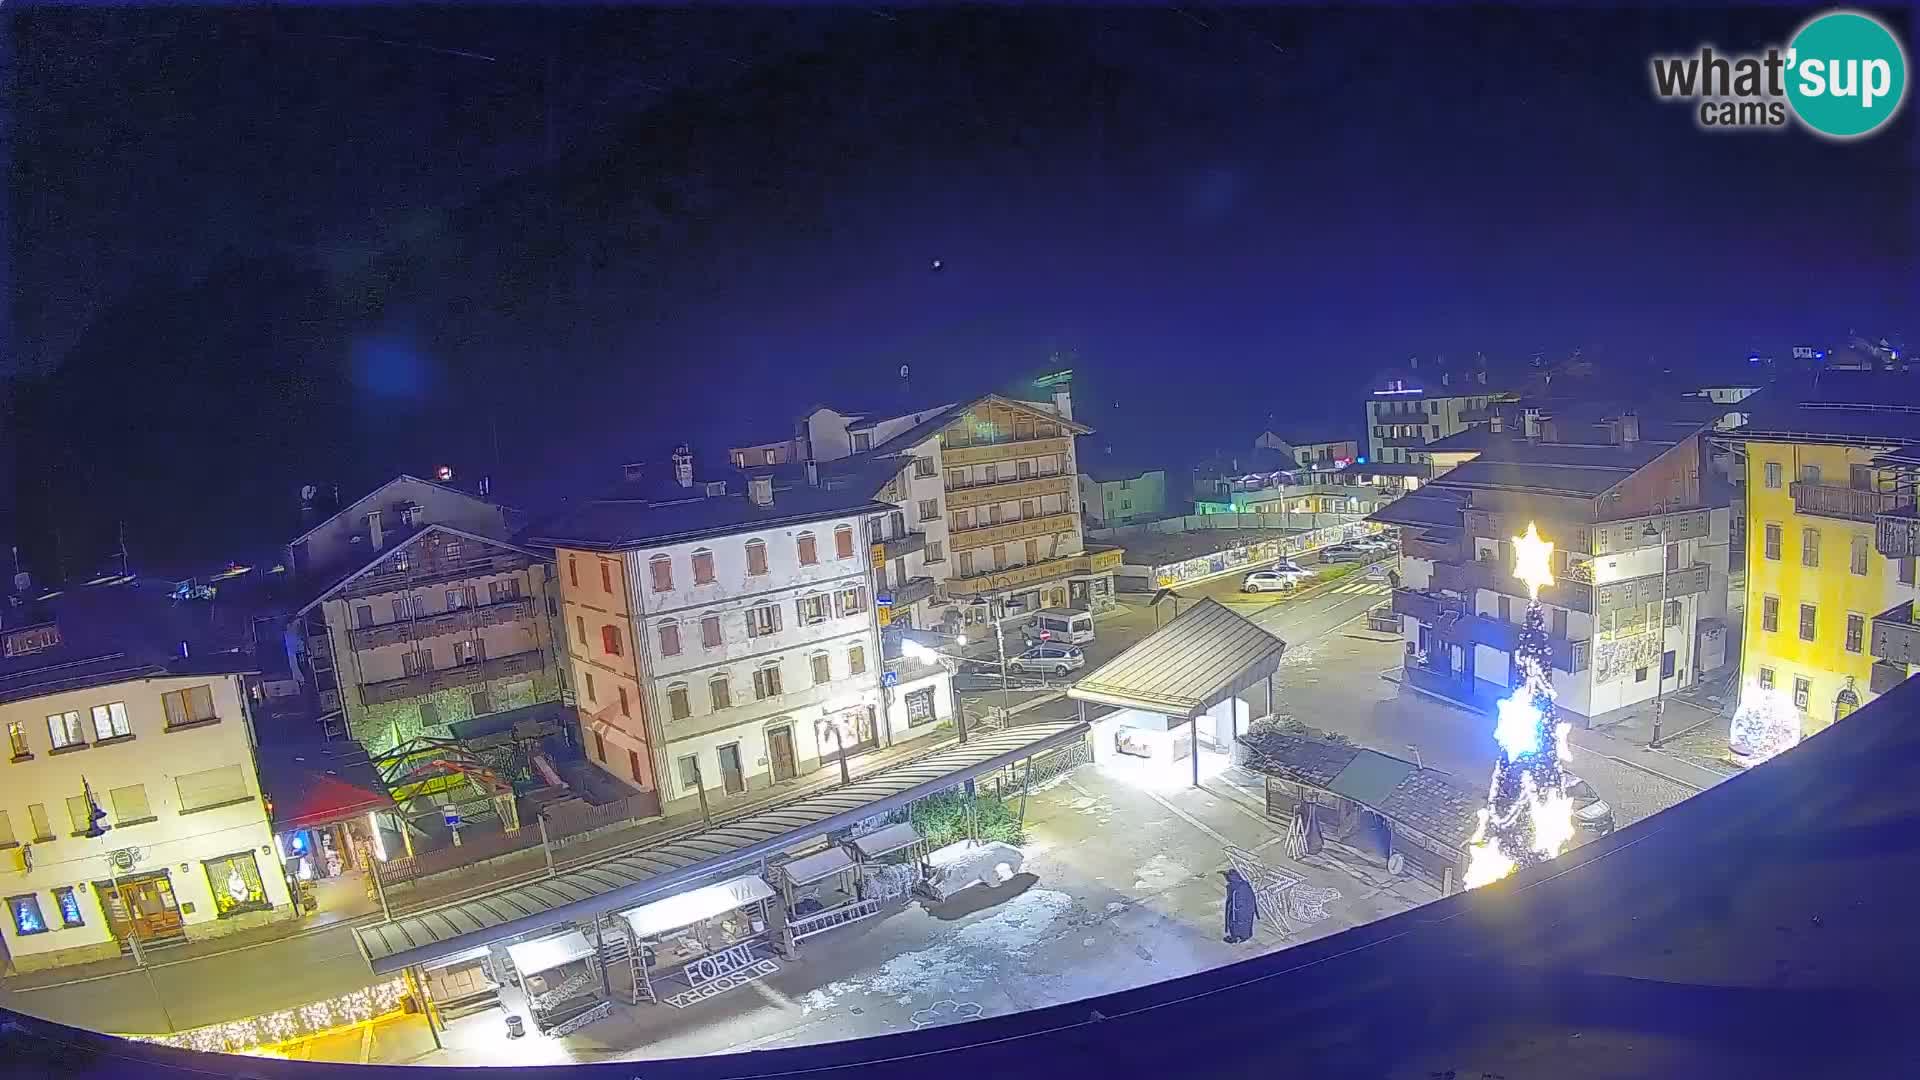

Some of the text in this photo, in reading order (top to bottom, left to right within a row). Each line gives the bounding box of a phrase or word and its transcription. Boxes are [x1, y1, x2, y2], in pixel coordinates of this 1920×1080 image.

[664, 960, 780, 1008] DI SOPRA
[684, 942, 757, 987] FORNI
